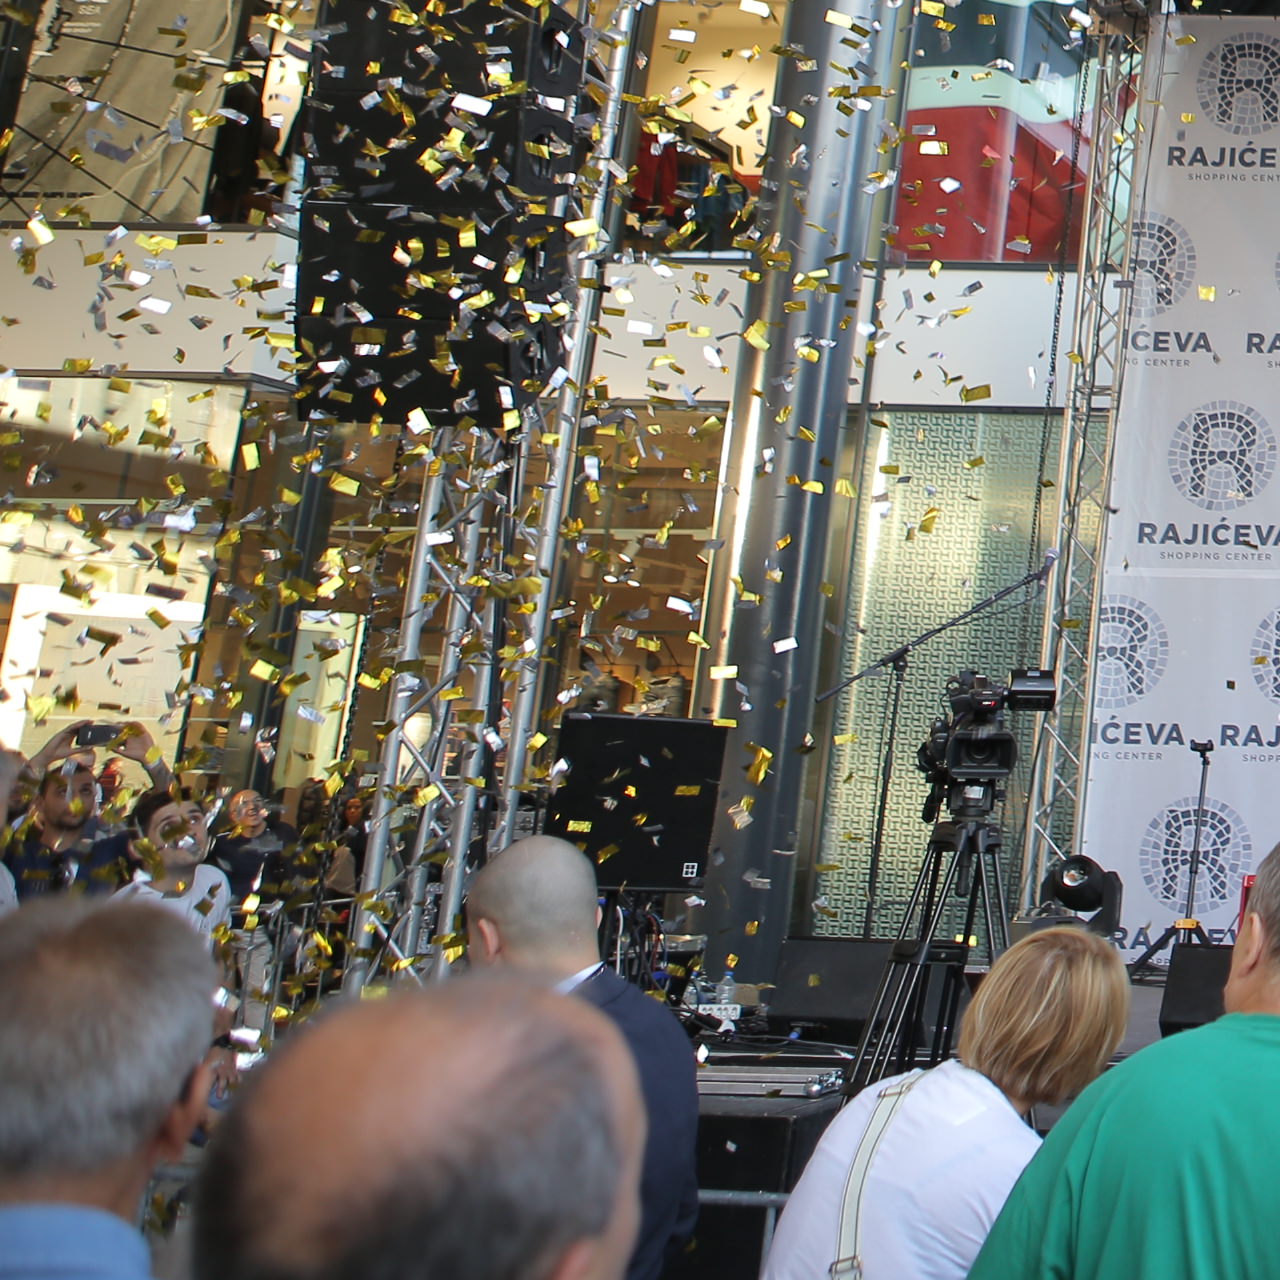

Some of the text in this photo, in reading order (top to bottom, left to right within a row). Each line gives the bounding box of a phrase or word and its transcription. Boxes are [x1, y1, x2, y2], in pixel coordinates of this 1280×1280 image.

[1187, 172, 1247, 182] SHOPPING
[1144, 359, 1191, 369] CENTER
[1159, 552, 1273, 562] SHOPPING CENTER
[1114, 751, 1164, 762] CENTER
